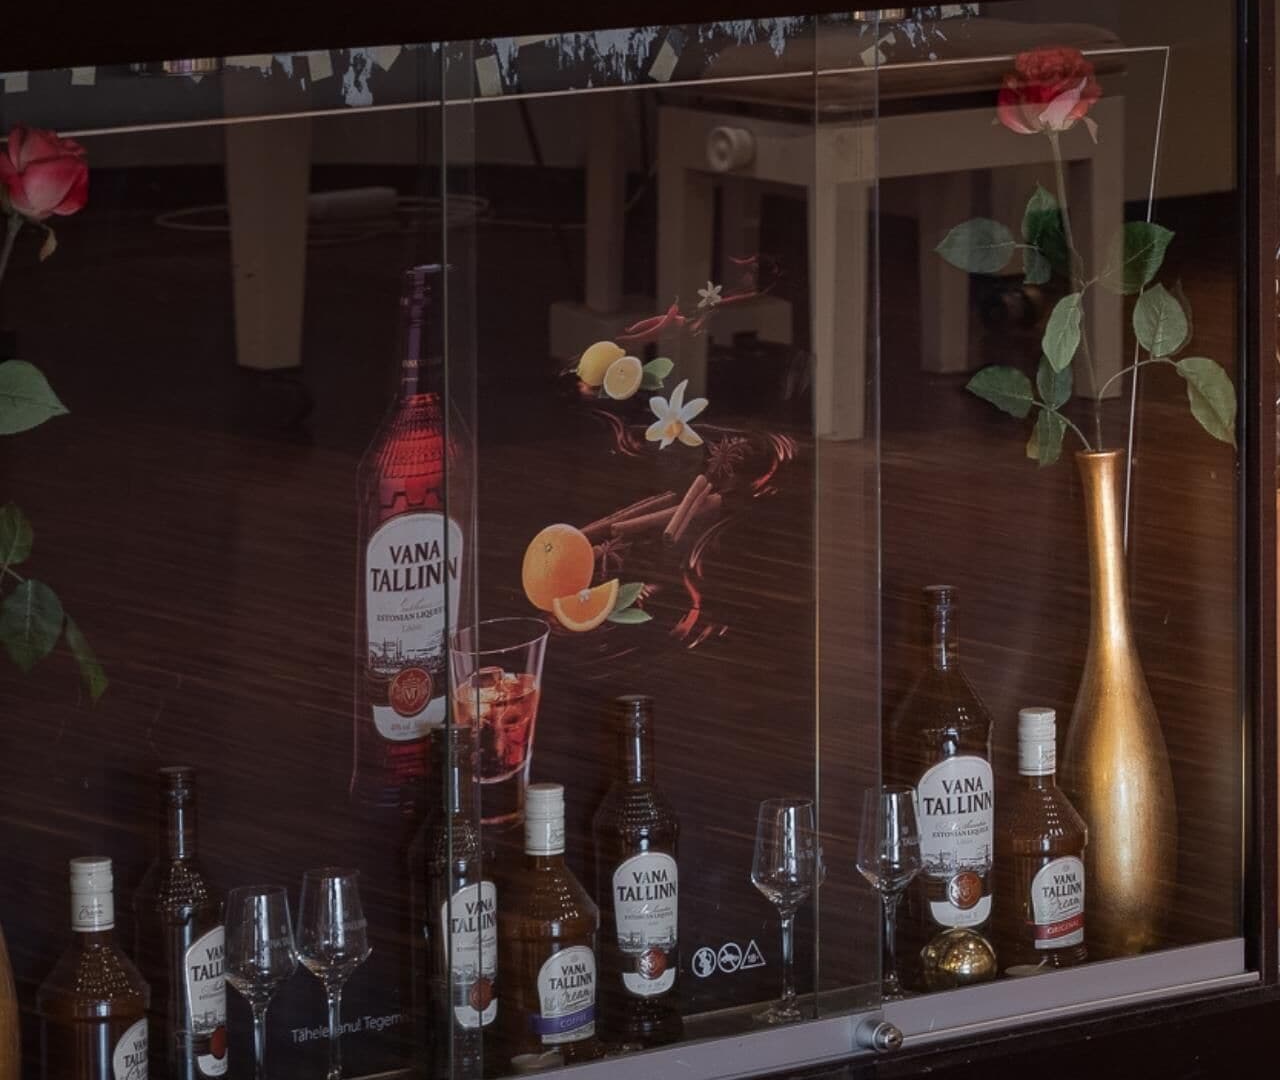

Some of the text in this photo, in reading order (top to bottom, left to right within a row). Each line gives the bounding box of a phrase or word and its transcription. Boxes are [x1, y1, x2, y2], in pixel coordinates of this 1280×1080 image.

[390, 540, 441, 565] VANA
[370, 557, 458, 593] TALLINN
[377, 610, 416, 623] ESTONIAN
[942, 776, 983, 794] VANA
[923, 790, 992, 815] TALLINN
[632, 869, 668, 884] VANA
[1053, 872, 1077, 885] VANA
[616, 880, 676, 902] TALLINN
[1042, 881, 1082, 897] TALLINN
[465, 898, 493, 914] VANA
[561, 963, 586, 976] VANA
[549, 972, 593, 990] TALLINN
